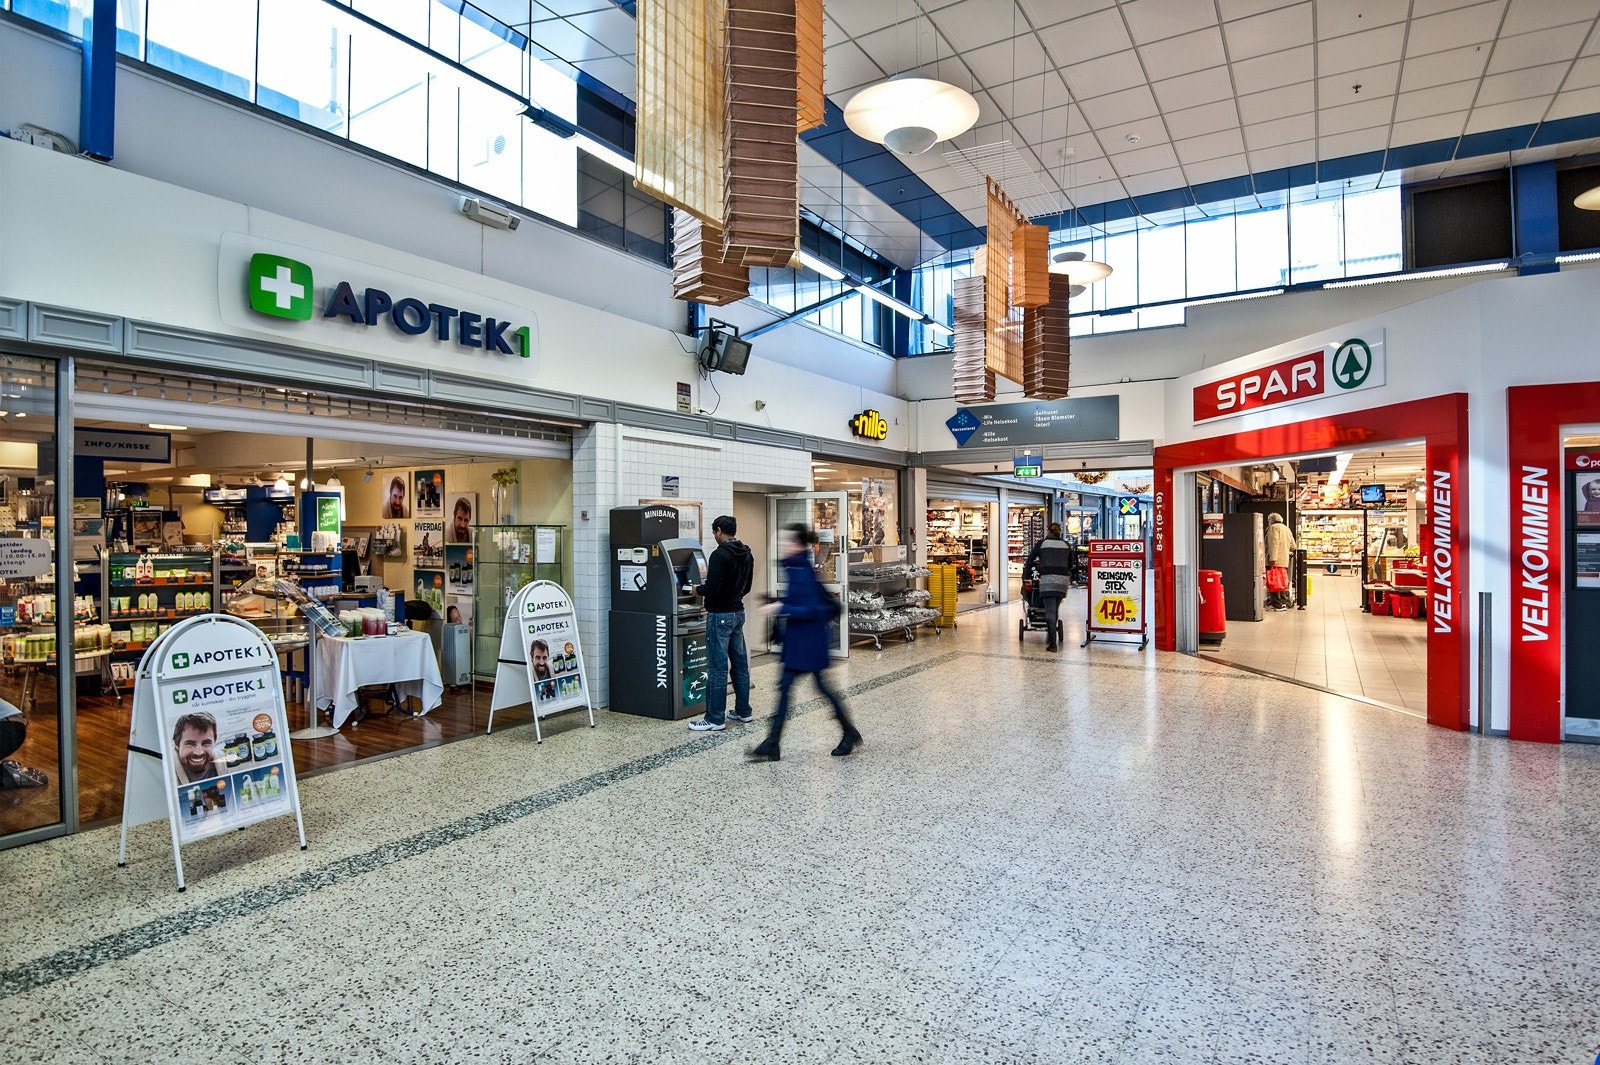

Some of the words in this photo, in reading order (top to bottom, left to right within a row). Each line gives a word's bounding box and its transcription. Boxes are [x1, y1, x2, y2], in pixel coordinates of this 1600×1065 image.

[322, 281, 514, 355] APOTEK
[514, 325, 531, 358] 1
[1215, 359, 1318, 411] SPAR
[84, 440, 151, 450] INFO/KASSE
[644, 510, 676, 520] MINIBANK
[414, 522, 442, 532] HVERDAG
[1433, 470, 1452, 634] VELKOMMEN
[1521, 465, 1549, 642] VELKOMMEN
[1097, 571, 1137, 582] REINSDYR-
[1104, 580, 1126, 590] STEK
[536, 600, 564, 611] APOTEK
[536, 622, 564, 632] APOTEK
[193, 647, 254, 664] APOTEK
[256, 646, 262, 656] 1
[656, 615, 668, 689] MINIBANK
[191, 680, 255, 700] APOTEK
[257, 678, 265, 690] 1
